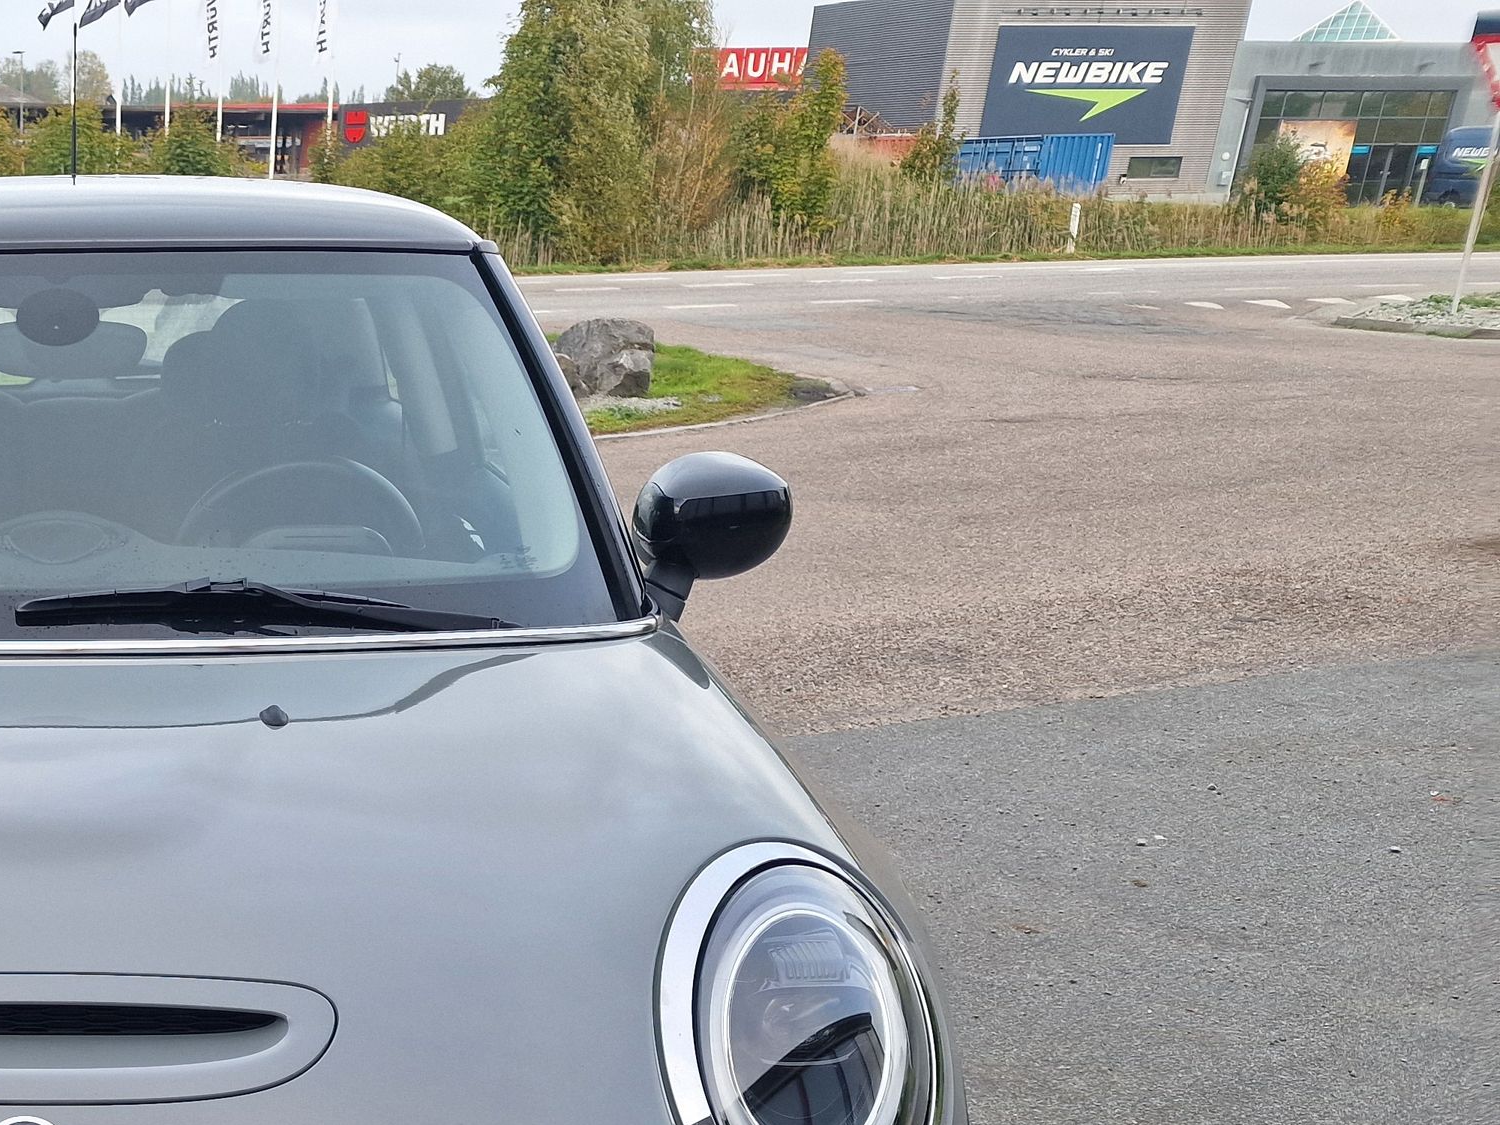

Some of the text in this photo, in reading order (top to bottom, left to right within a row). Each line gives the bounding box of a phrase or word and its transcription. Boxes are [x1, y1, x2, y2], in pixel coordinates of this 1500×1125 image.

[1051, 48, 1114, 56] CYKLER & SKI
[1008, 61, 1169, 84] NEWBIKE
